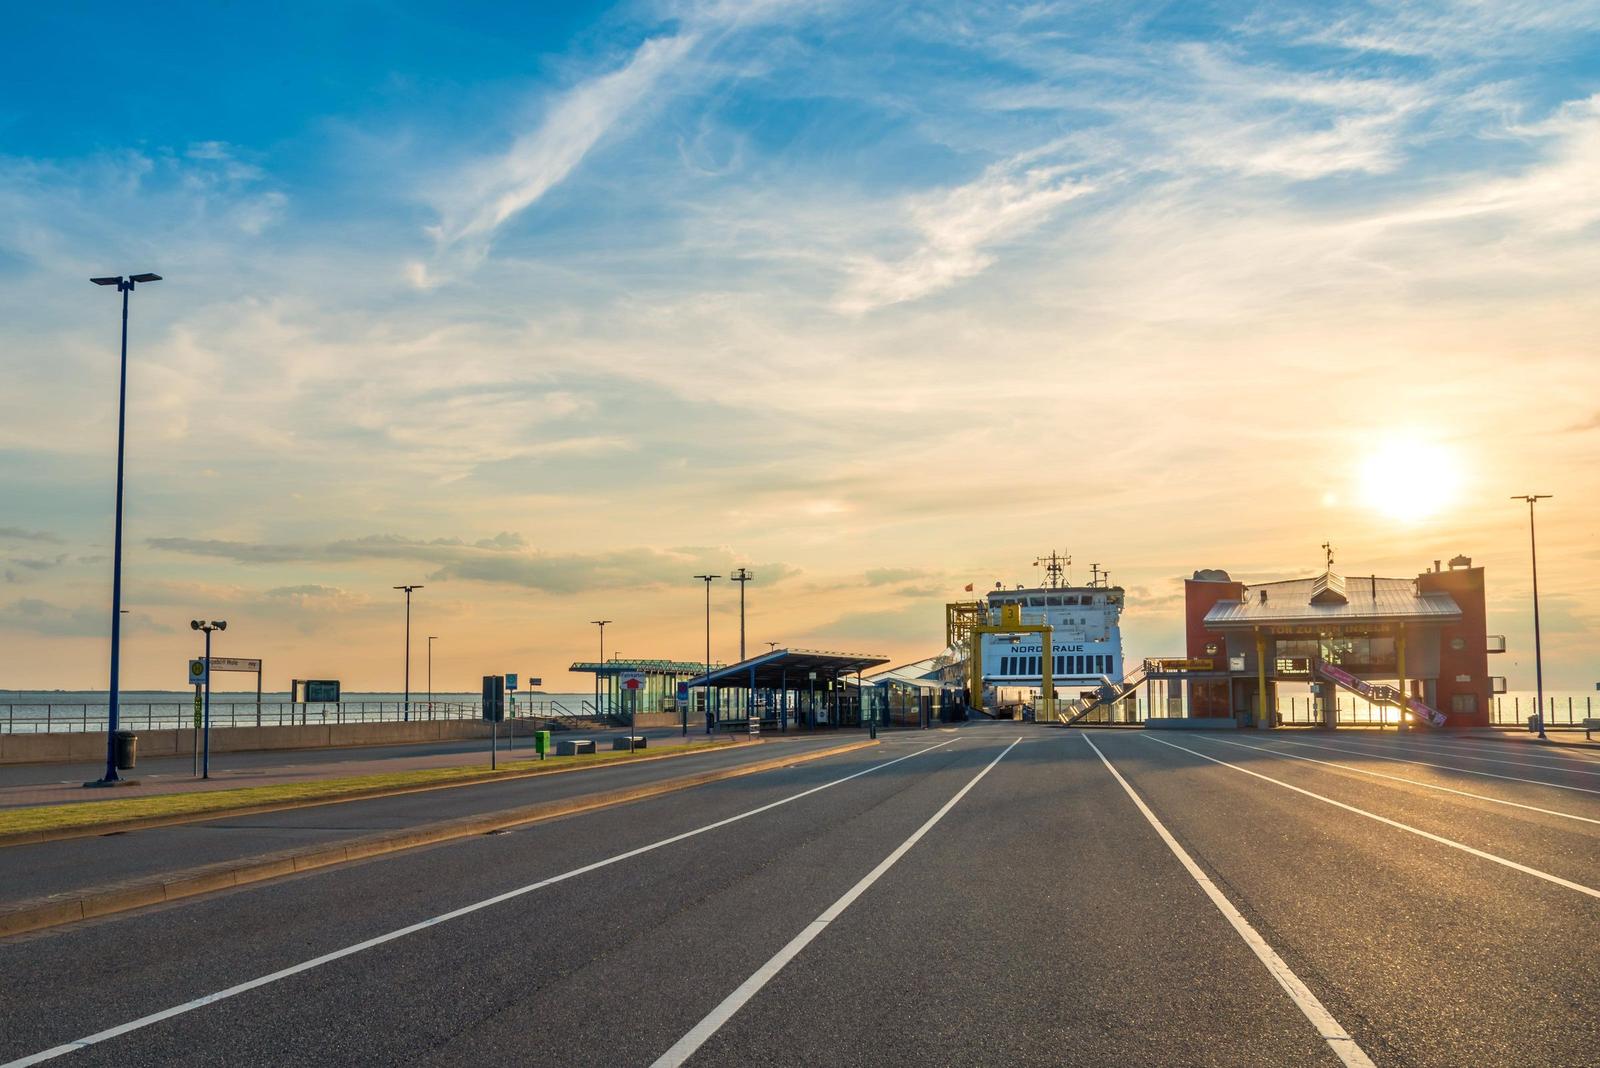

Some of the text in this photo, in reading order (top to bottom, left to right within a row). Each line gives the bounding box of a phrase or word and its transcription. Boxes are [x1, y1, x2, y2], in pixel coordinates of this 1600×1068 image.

[1008, 609, 1014, 618] 3
[1271, 625, 1293, 634] TOR
[1296, 625, 1312, 634] ZU
